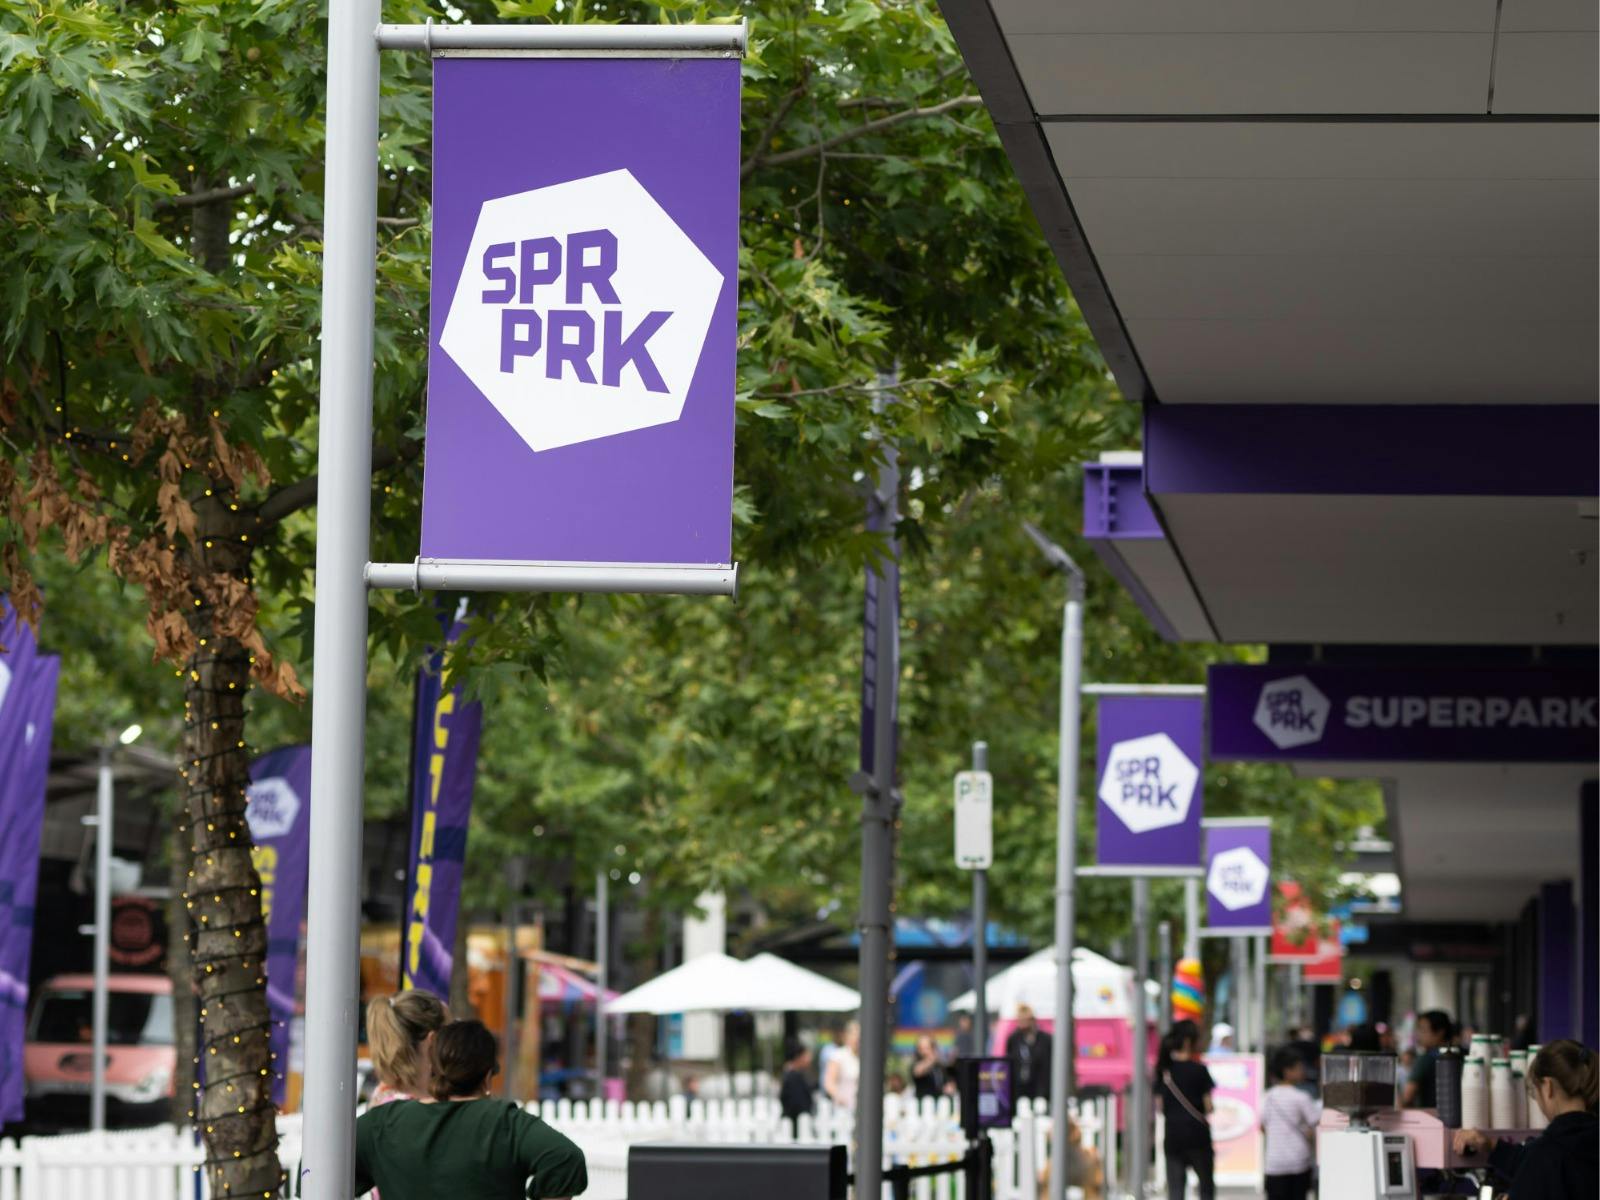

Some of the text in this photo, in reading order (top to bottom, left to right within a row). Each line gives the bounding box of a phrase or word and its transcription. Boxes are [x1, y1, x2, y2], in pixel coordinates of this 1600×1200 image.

[481, 228, 622, 305] SPR
[499, 308, 675, 394] PRK
[1270, 710, 1317, 735] PRK
[1344, 696, 1599, 728] SUPERPARK
[1115, 756, 1160, 781] SPR
[1122, 783, 1178, 809] PRK
